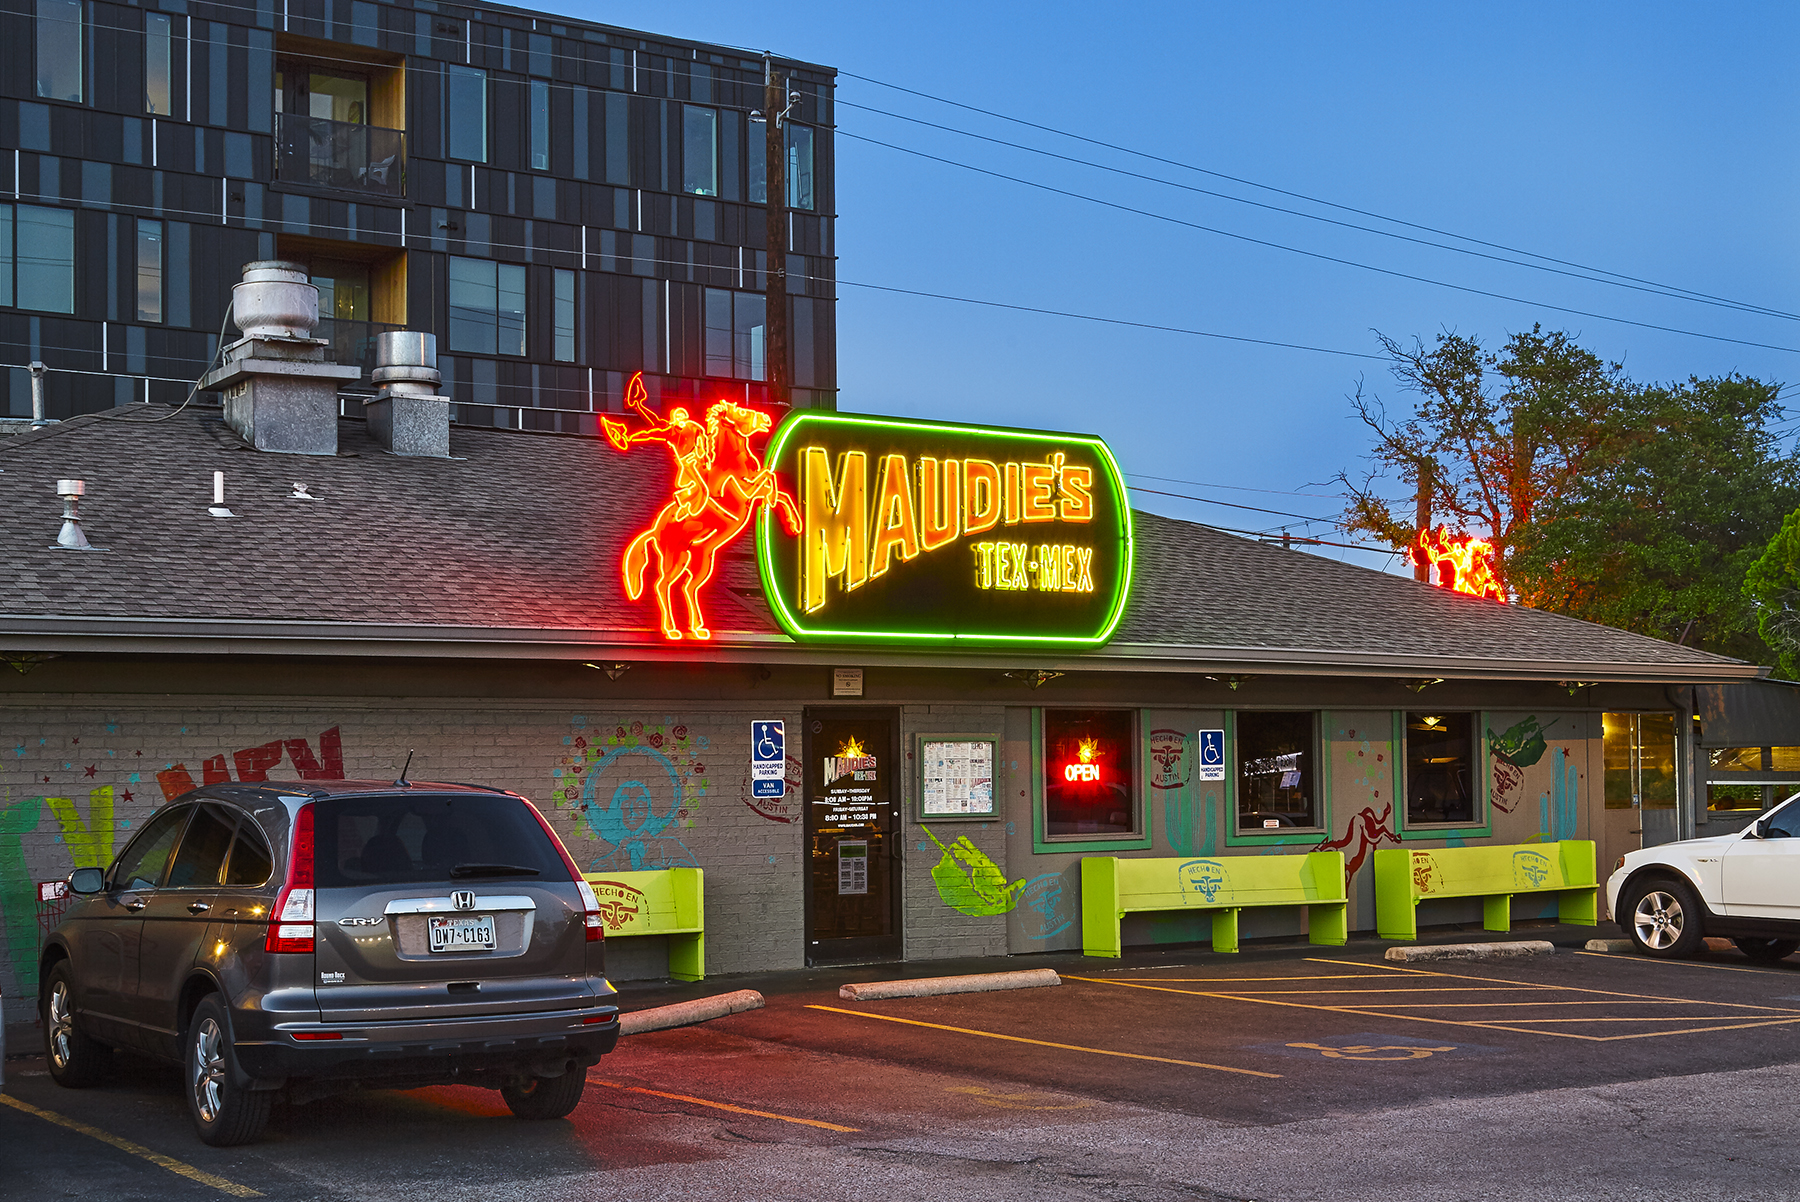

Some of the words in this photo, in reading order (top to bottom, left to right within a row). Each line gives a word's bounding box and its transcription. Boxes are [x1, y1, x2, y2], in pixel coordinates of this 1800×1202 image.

[800, 445, 1094, 615] MAUDIE'S
[1151, 734, 1173, 745] HECHO
[823, 753, 877, 788] MAUDIE'S
[1064, 763, 1100, 782] OPEN
[1154, 773, 1180, 783] AUSTIN
[757, 798, 788, 814] AUSTIN
[1188, 866, 1210, 876] HECHO
[1211, 867, 1221, 875] EN
[593, 887, 625, 898] HECHO
[625, 892, 639, 904] EN
[1024, 880, 1048, 898] HECHO
[338, 916, 385, 926] CR-V
[447, 919, 475, 927] TEXAS
[1039, 913, 1066, 934] AUSTIN
[463, 927, 491, 943] C163
